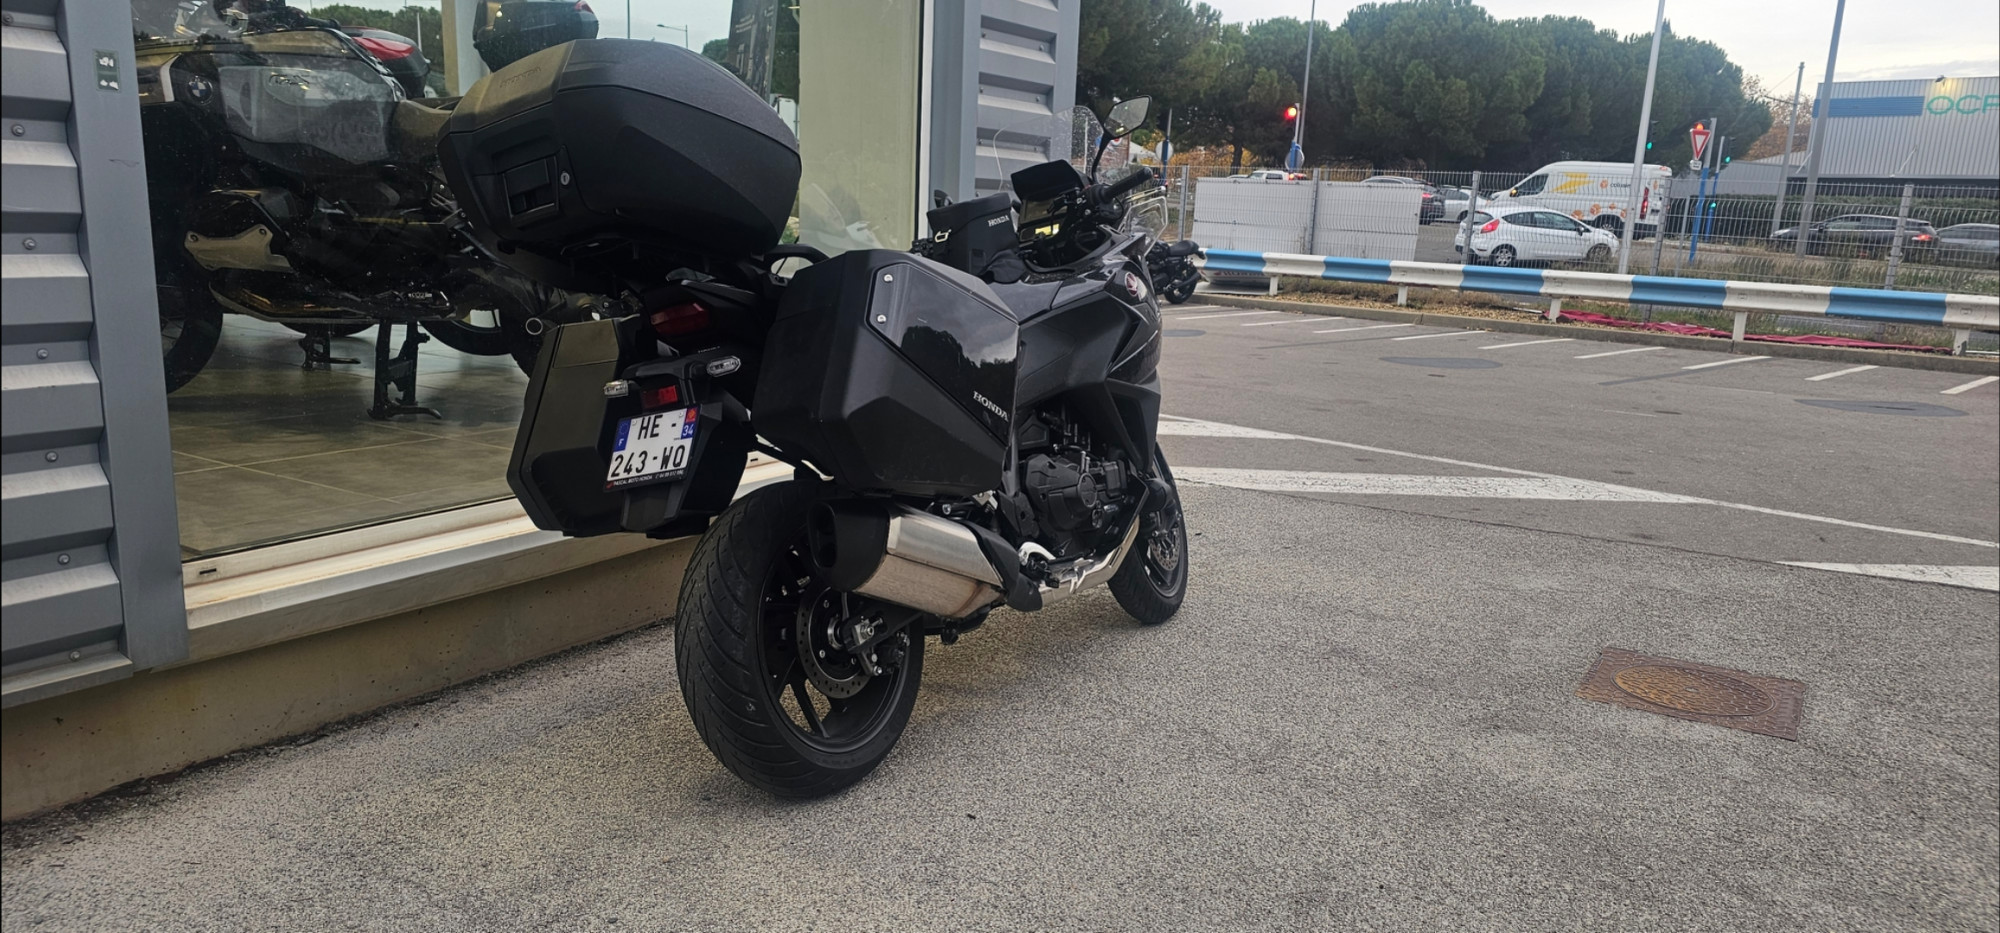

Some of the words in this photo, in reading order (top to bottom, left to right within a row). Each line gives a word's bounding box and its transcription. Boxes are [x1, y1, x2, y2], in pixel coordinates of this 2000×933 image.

[987, 214, 1010, 227] HONDA
[973, 390, 1009, 422] HONDA
[637, 414, 663, 440] HE
[682, 424, 694, 437] 34
[618, 438, 624, 446] F
